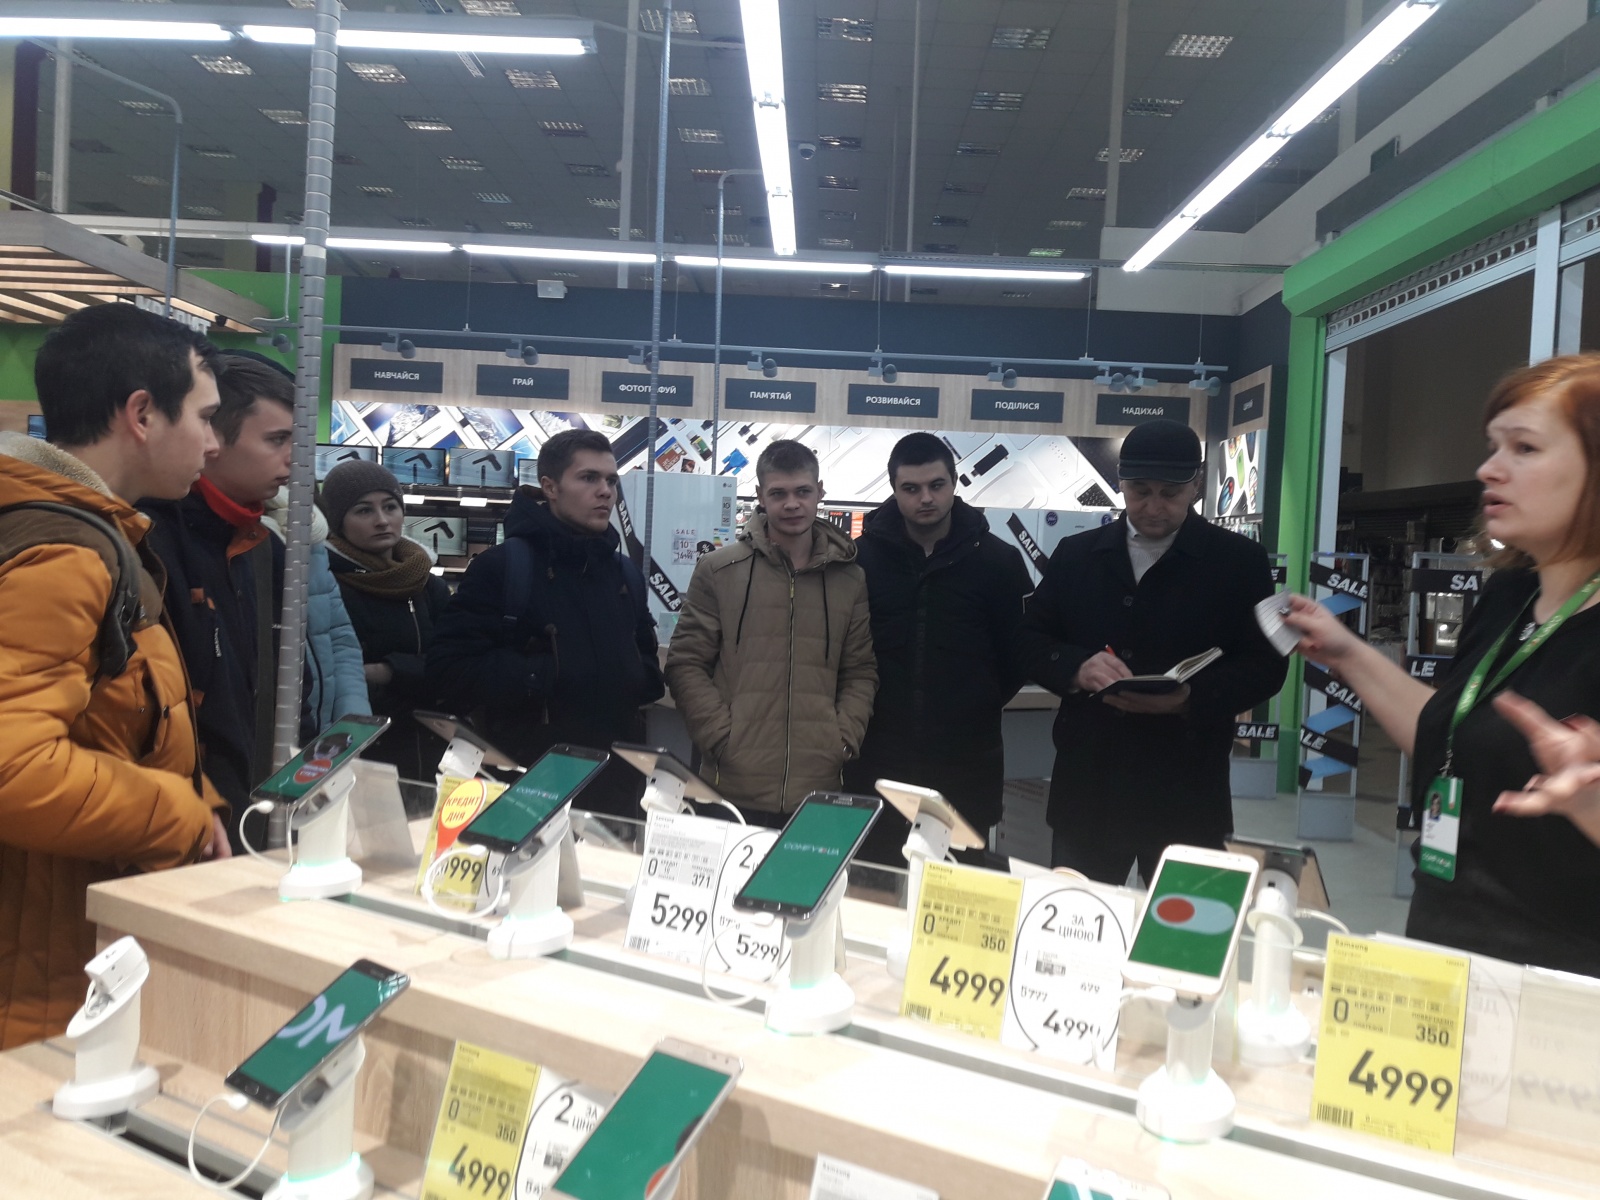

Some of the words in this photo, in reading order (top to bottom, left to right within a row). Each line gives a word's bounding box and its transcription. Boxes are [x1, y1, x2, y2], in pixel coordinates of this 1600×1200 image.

[373, 369, 420, 381] НАВЧАЙСЯ
[512, 375, 534, 387] ГРАЙ
[749, 389, 792, 401] ПАМ'ЯТАЙ
[865, 394, 921, 407] РОЗВИВАЙСЯ
[995, 400, 1040, 411] ПОДІЛИСЯ
[1122, 404, 1164, 416] НАДИХАЙ
[617, 499, 632, 538] SALE
[675, 528, 696, 536] SALE
[1018, 529, 1042, 561] SALE
[649, 572, 682, 612] SALE
[1327, 573, 1368, 599] SALE
[1450, 574, 1478, 592] SA
[1411, 660, 1437, 677] LE
[1237, 724, 1277, 739] SALE
[446, 796, 481, 808] КРЕДИТ
[446, 811, 466, 823] ДНЯ
[738, 843, 754, 870] 2
[648, 857, 658, 877] 0
[691, 871, 712, 889] 371
[650, 892, 709, 936] 5299
[923, 912, 935, 935] 0
[1041, 903, 1058, 932] 2
[1071, 914, 1085, 926] ЗА
[1058, 925, 1095, 943] ЦІНОЮ
[1094, 914, 1106, 943] 1
[736, 932, 780, 963] 5299
[980, 933, 1006, 952] 350
[1335, 938, 1369, 953] Samsung
[930, 956, 1006, 1007] 4999
[1333, 997, 1350, 1024] 0
[1415, 1022, 1450, 1047] 350
[1348, 1048, 1454, 1113] 4999
[448, 1098, 460, 1120] 0
[554, 1094, 574, 1125] 2
[448, 1143, 511, 1200] 4999
